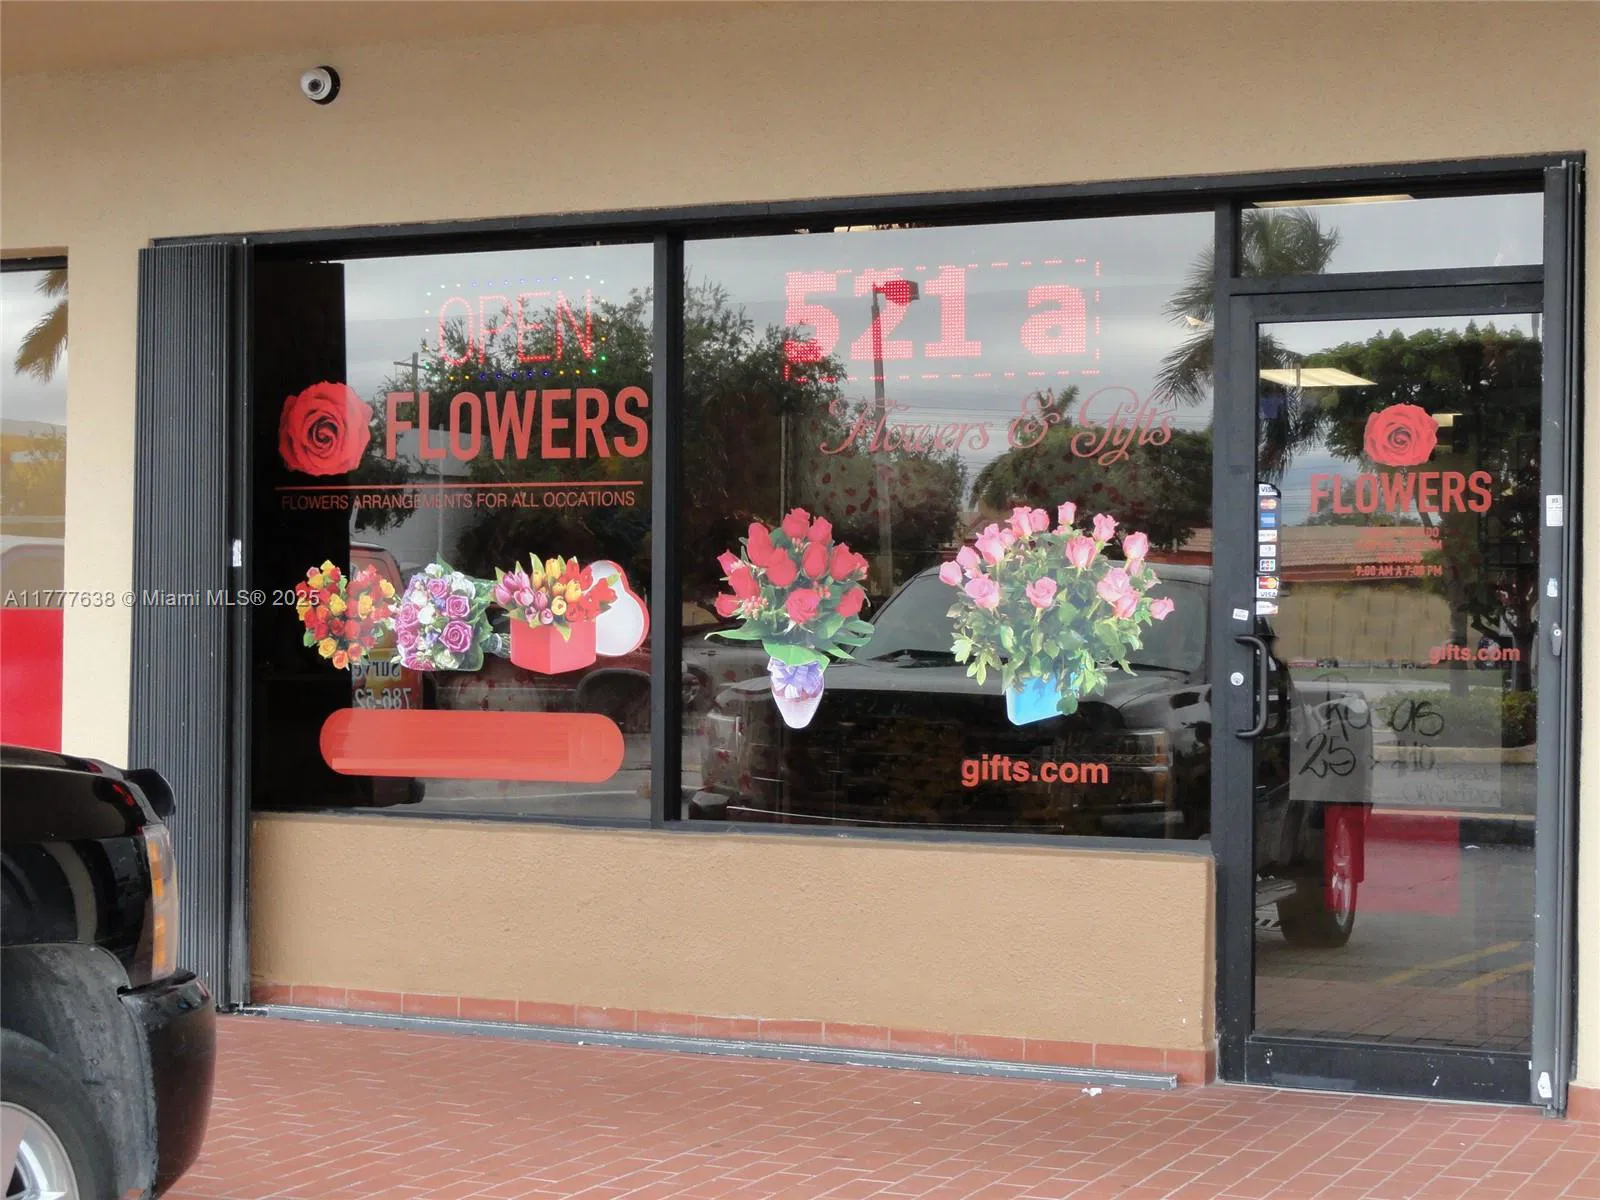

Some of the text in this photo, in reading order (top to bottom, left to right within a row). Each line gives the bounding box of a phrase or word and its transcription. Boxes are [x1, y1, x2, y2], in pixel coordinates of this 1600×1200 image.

[438, 289, 594, 367] OPEN
[784, 266, 981, 363] 521
[385, 386, 649, 461] FLOWERS
[820, 386, 1178, 466] Flowers & Gifts
[281, 491, 635, 510] FLOWERS ARRANGEMENTS FOR ALL OCCATIONS
[1309, 470, 1493, 514] FLOWERS
[1428, 643, 1521, 664] gifts.com
[960, 754, 1109, 787] gifts.com
